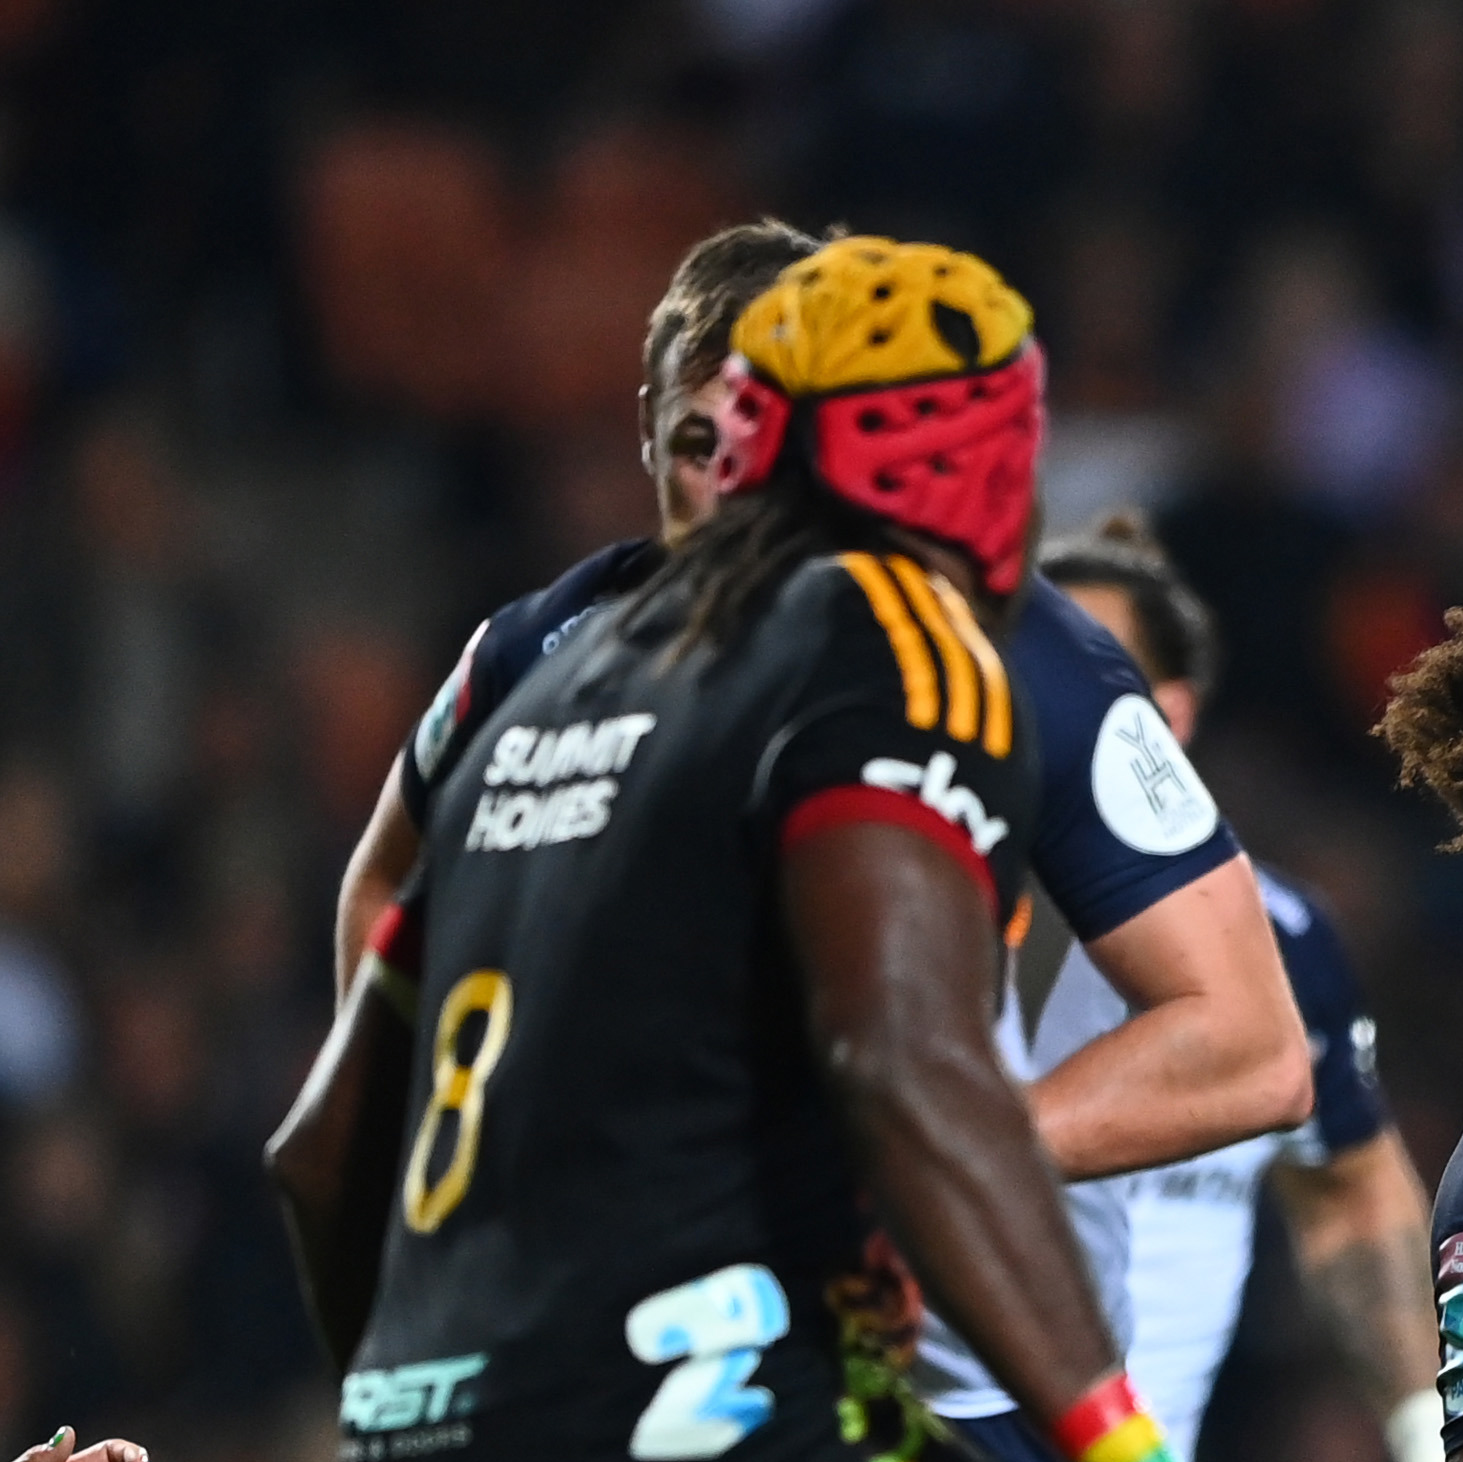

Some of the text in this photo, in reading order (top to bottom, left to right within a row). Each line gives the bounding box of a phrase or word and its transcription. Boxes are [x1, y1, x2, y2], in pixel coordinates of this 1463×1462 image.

[483, 713, 657, 787] SUMMIT
[465, 776, 619, 852] HOMES
[403, 968, 514, 1235] 8
